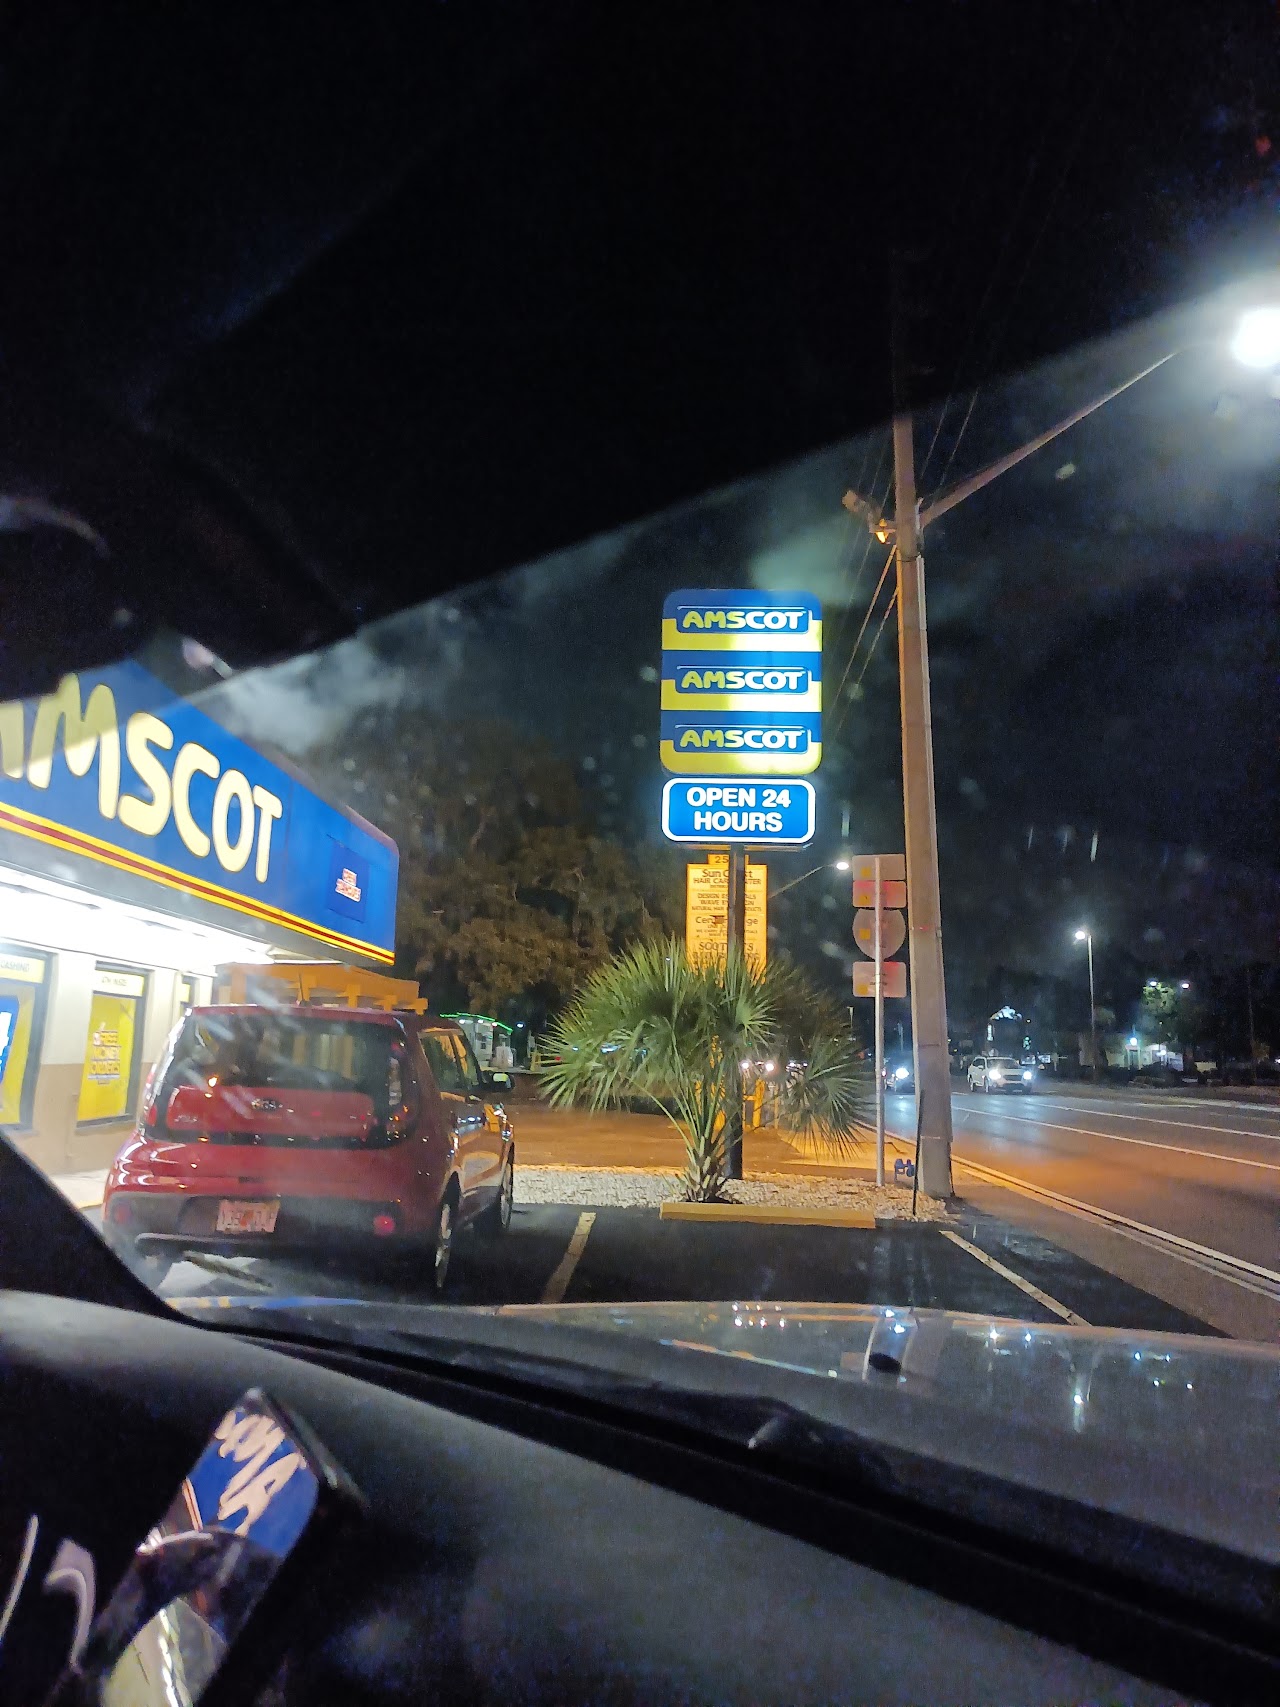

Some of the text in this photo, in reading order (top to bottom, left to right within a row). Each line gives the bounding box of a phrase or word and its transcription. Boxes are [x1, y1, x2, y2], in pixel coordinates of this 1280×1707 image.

[682, 610, 806, 629] AMSCOT
[681, 670, 806, 690] AMSCOT
[679, 729, 806, 749] AMSCOT
[686, 786, 791, 808] OPEN 24
[693, 811, 783, 833] HOURS
